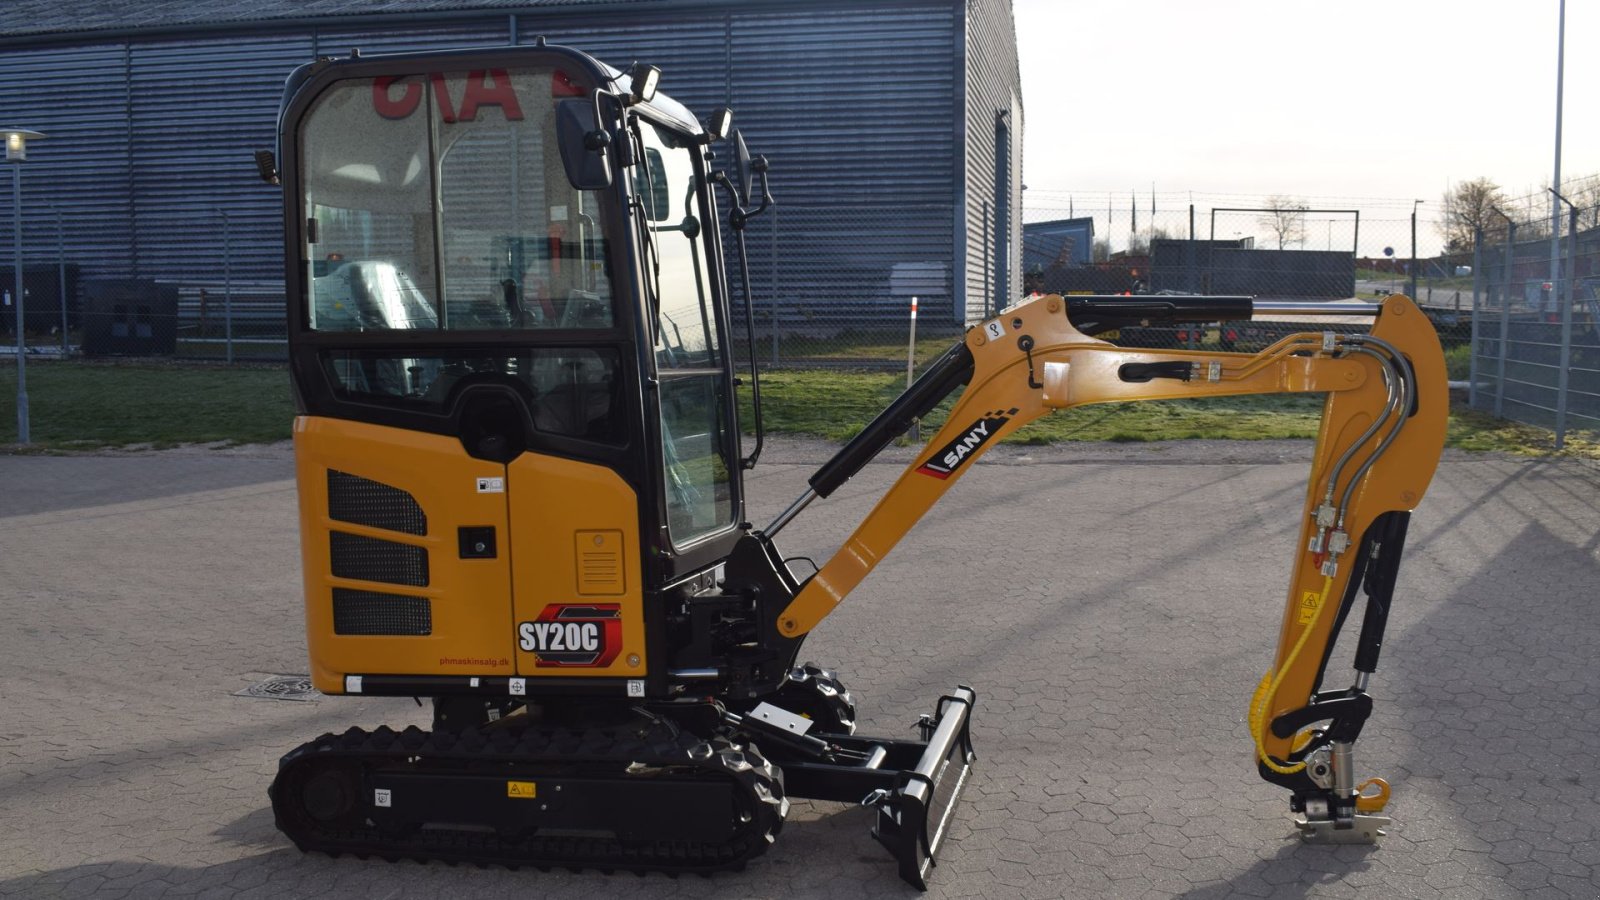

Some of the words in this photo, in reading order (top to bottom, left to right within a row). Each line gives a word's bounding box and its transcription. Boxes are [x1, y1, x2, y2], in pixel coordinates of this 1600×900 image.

[944, 421, 988, 468] SANY
[519, 623, 598, 651] SY20C
[439, 656, 509, 668] phmaskinsalg.dk
